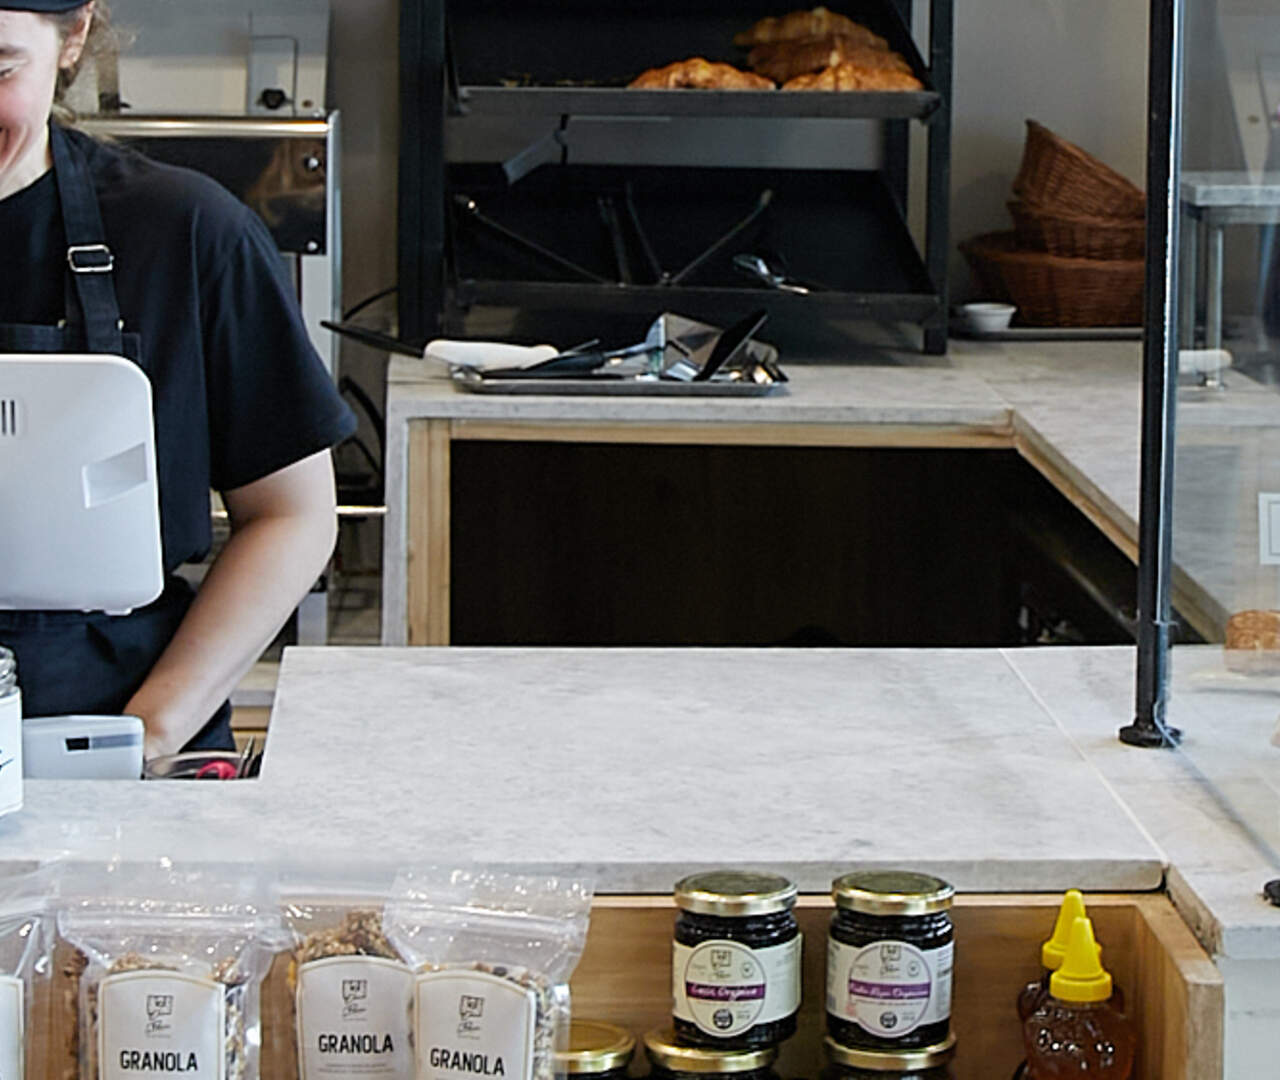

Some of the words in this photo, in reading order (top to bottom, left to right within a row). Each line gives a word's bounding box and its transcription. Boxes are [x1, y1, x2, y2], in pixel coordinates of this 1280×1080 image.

[318, 1034, 395, 1053] GRANOLA
[120, 1050, 199, 1071] GRANOLA
[430, 1048, 506, 1076] GRANOLA
